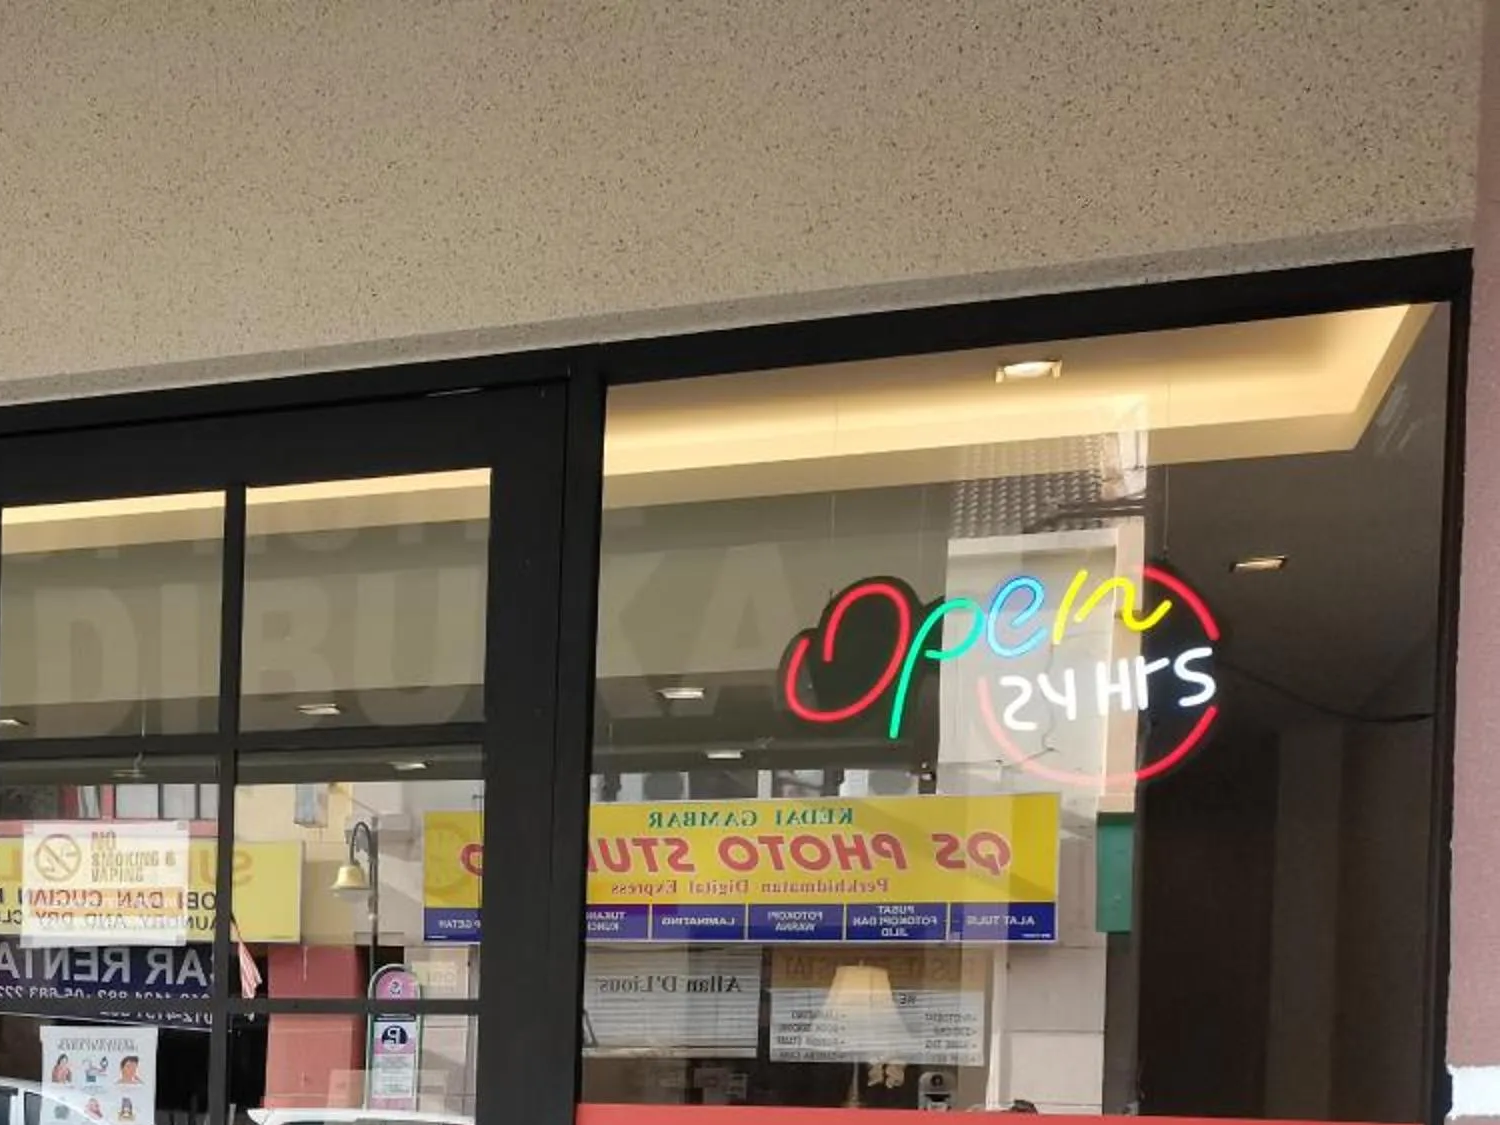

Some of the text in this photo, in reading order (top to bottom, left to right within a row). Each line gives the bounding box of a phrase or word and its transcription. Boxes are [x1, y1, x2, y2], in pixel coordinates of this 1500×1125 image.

[785, 569, 1172, 740] Open
[998, 667, 1077, 732] 24
[91, 831, 117, 851] NO
[91, 850, 160, 868] SMOKING
[91, 866, 145, 883] VAPING
